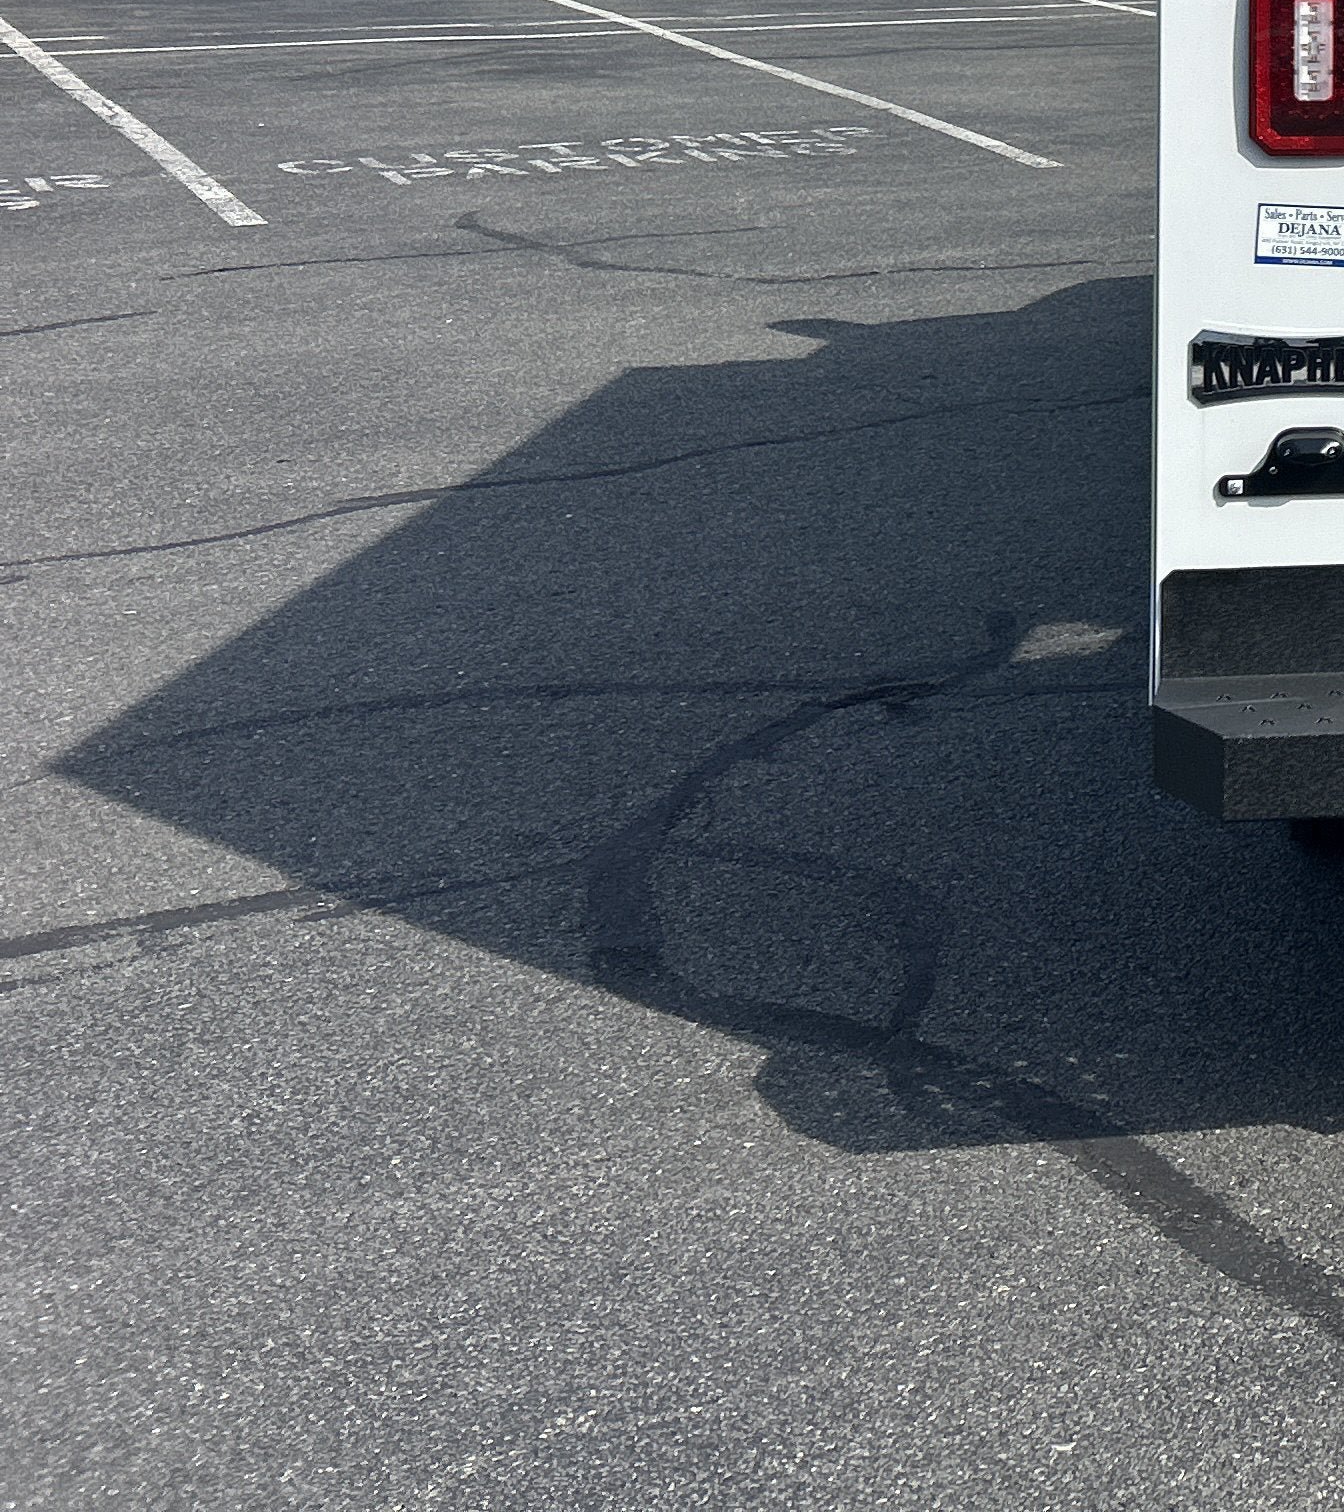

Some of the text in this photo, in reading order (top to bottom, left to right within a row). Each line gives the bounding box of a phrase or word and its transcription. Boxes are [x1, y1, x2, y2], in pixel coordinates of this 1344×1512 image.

[277, 127, 887, 175] CUSTOMER
[380, 142, 857, 186] PARKING
[1264, 208, 1287, 220] Sales
[1295, 209, 1318, 221] Parts
[1278, 222, 1342, 237] DEJANA
[1271, 245, 1297, 256] (631)
